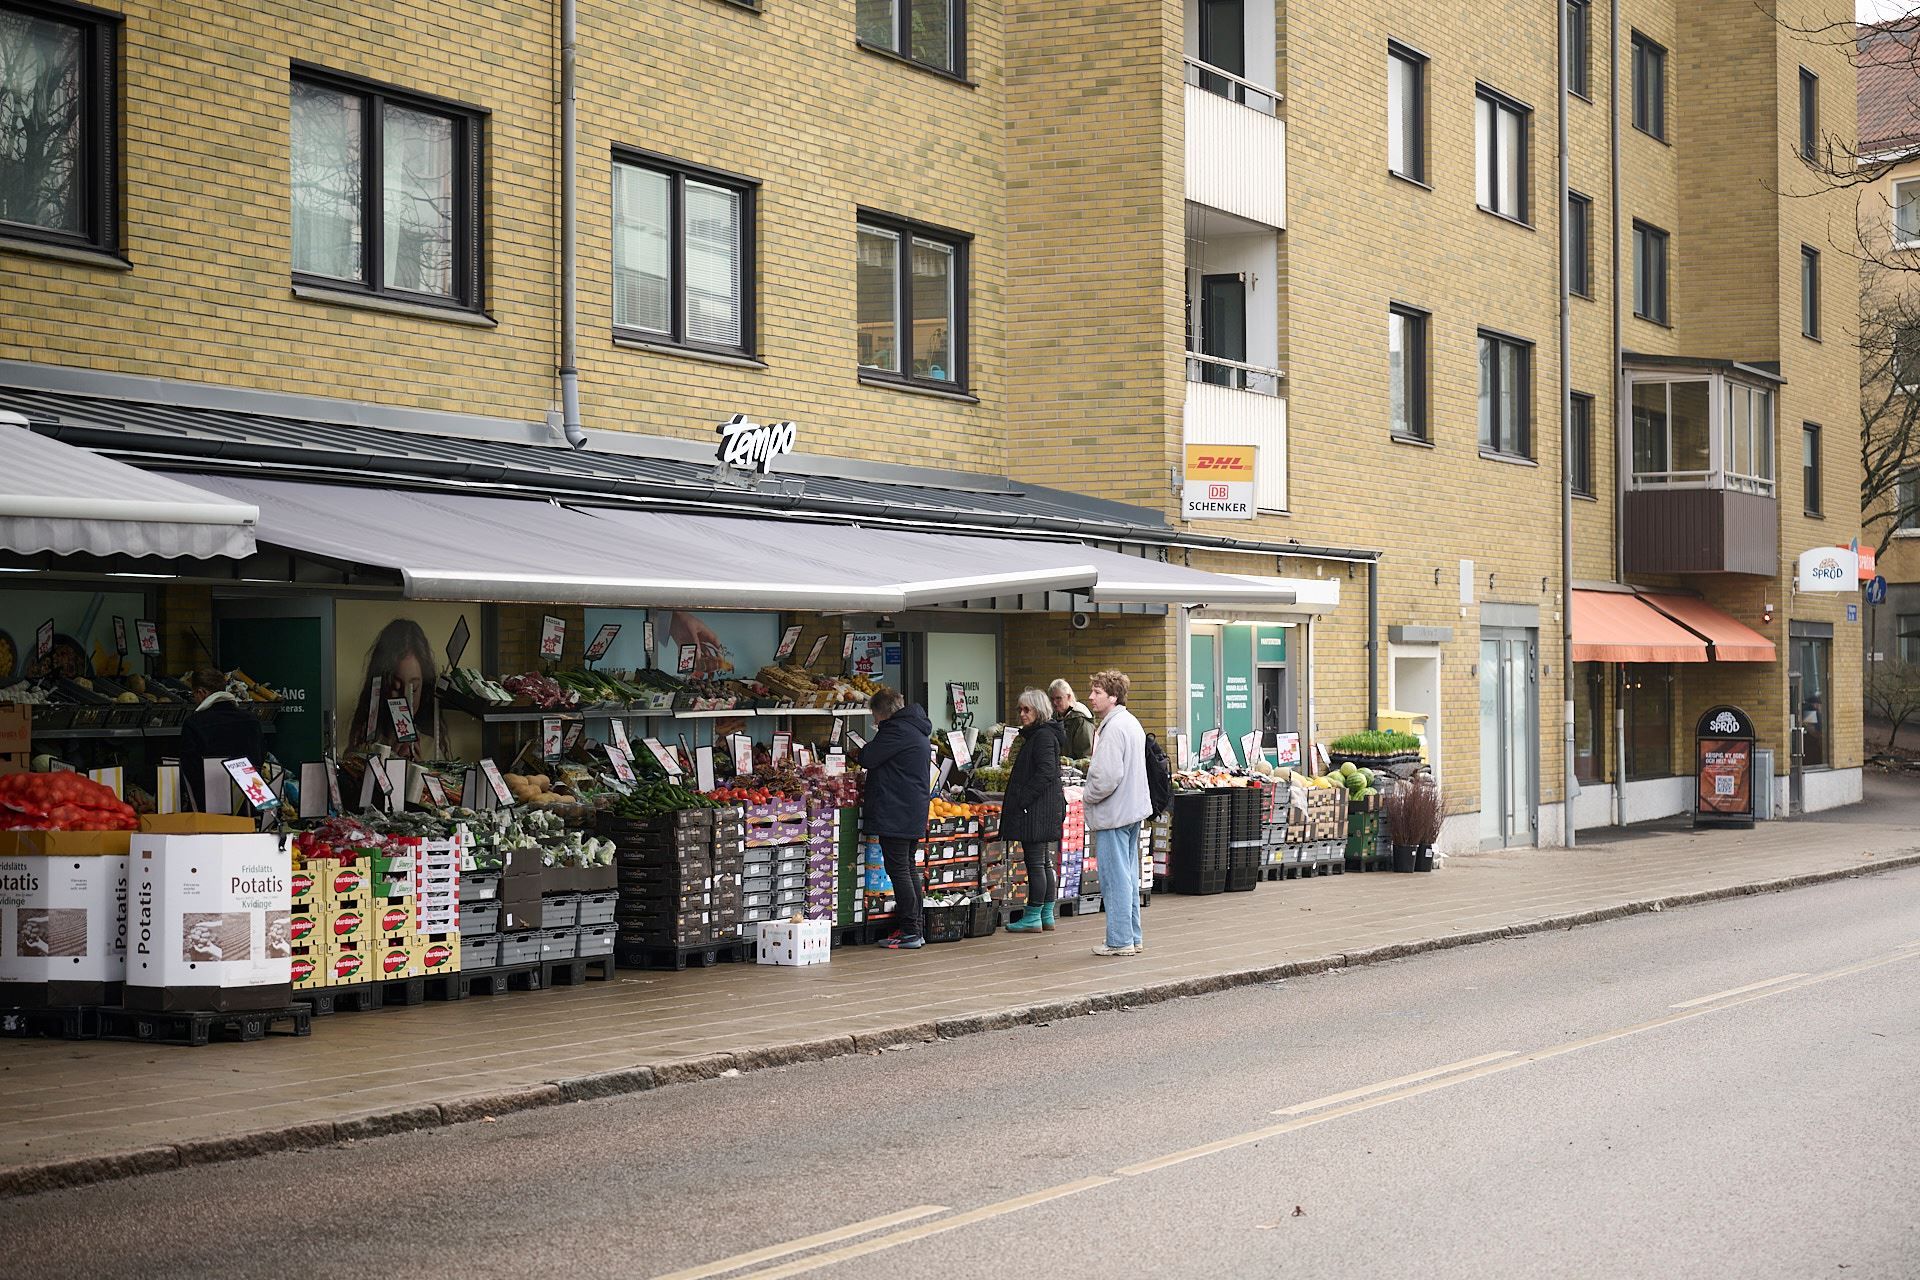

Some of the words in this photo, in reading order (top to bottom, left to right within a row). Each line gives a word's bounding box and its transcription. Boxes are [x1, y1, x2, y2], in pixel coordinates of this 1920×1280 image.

[721, 413, 797, 475] tempo
[1197, 457, 1243, 470] DHL
[1189, 501, 1246, 512] SCHENKER
[1812, 566, 1843, 579] SPRÖD
[1710, 720, 1740, 733] SPRÖD
[0, 862, 27, 871] ridslätts
[242, 865, 273, 873] Fridslätts
[0, 873, 39, 891] tatis
[232, 876, 283, 894] Potatis
[0, 897, 26, 908] vidinge
[242, 899, 273, 910] Kvidinge
[115, 878, 127, 949] Potatis
[138, 882, 151, 954] Potatis
